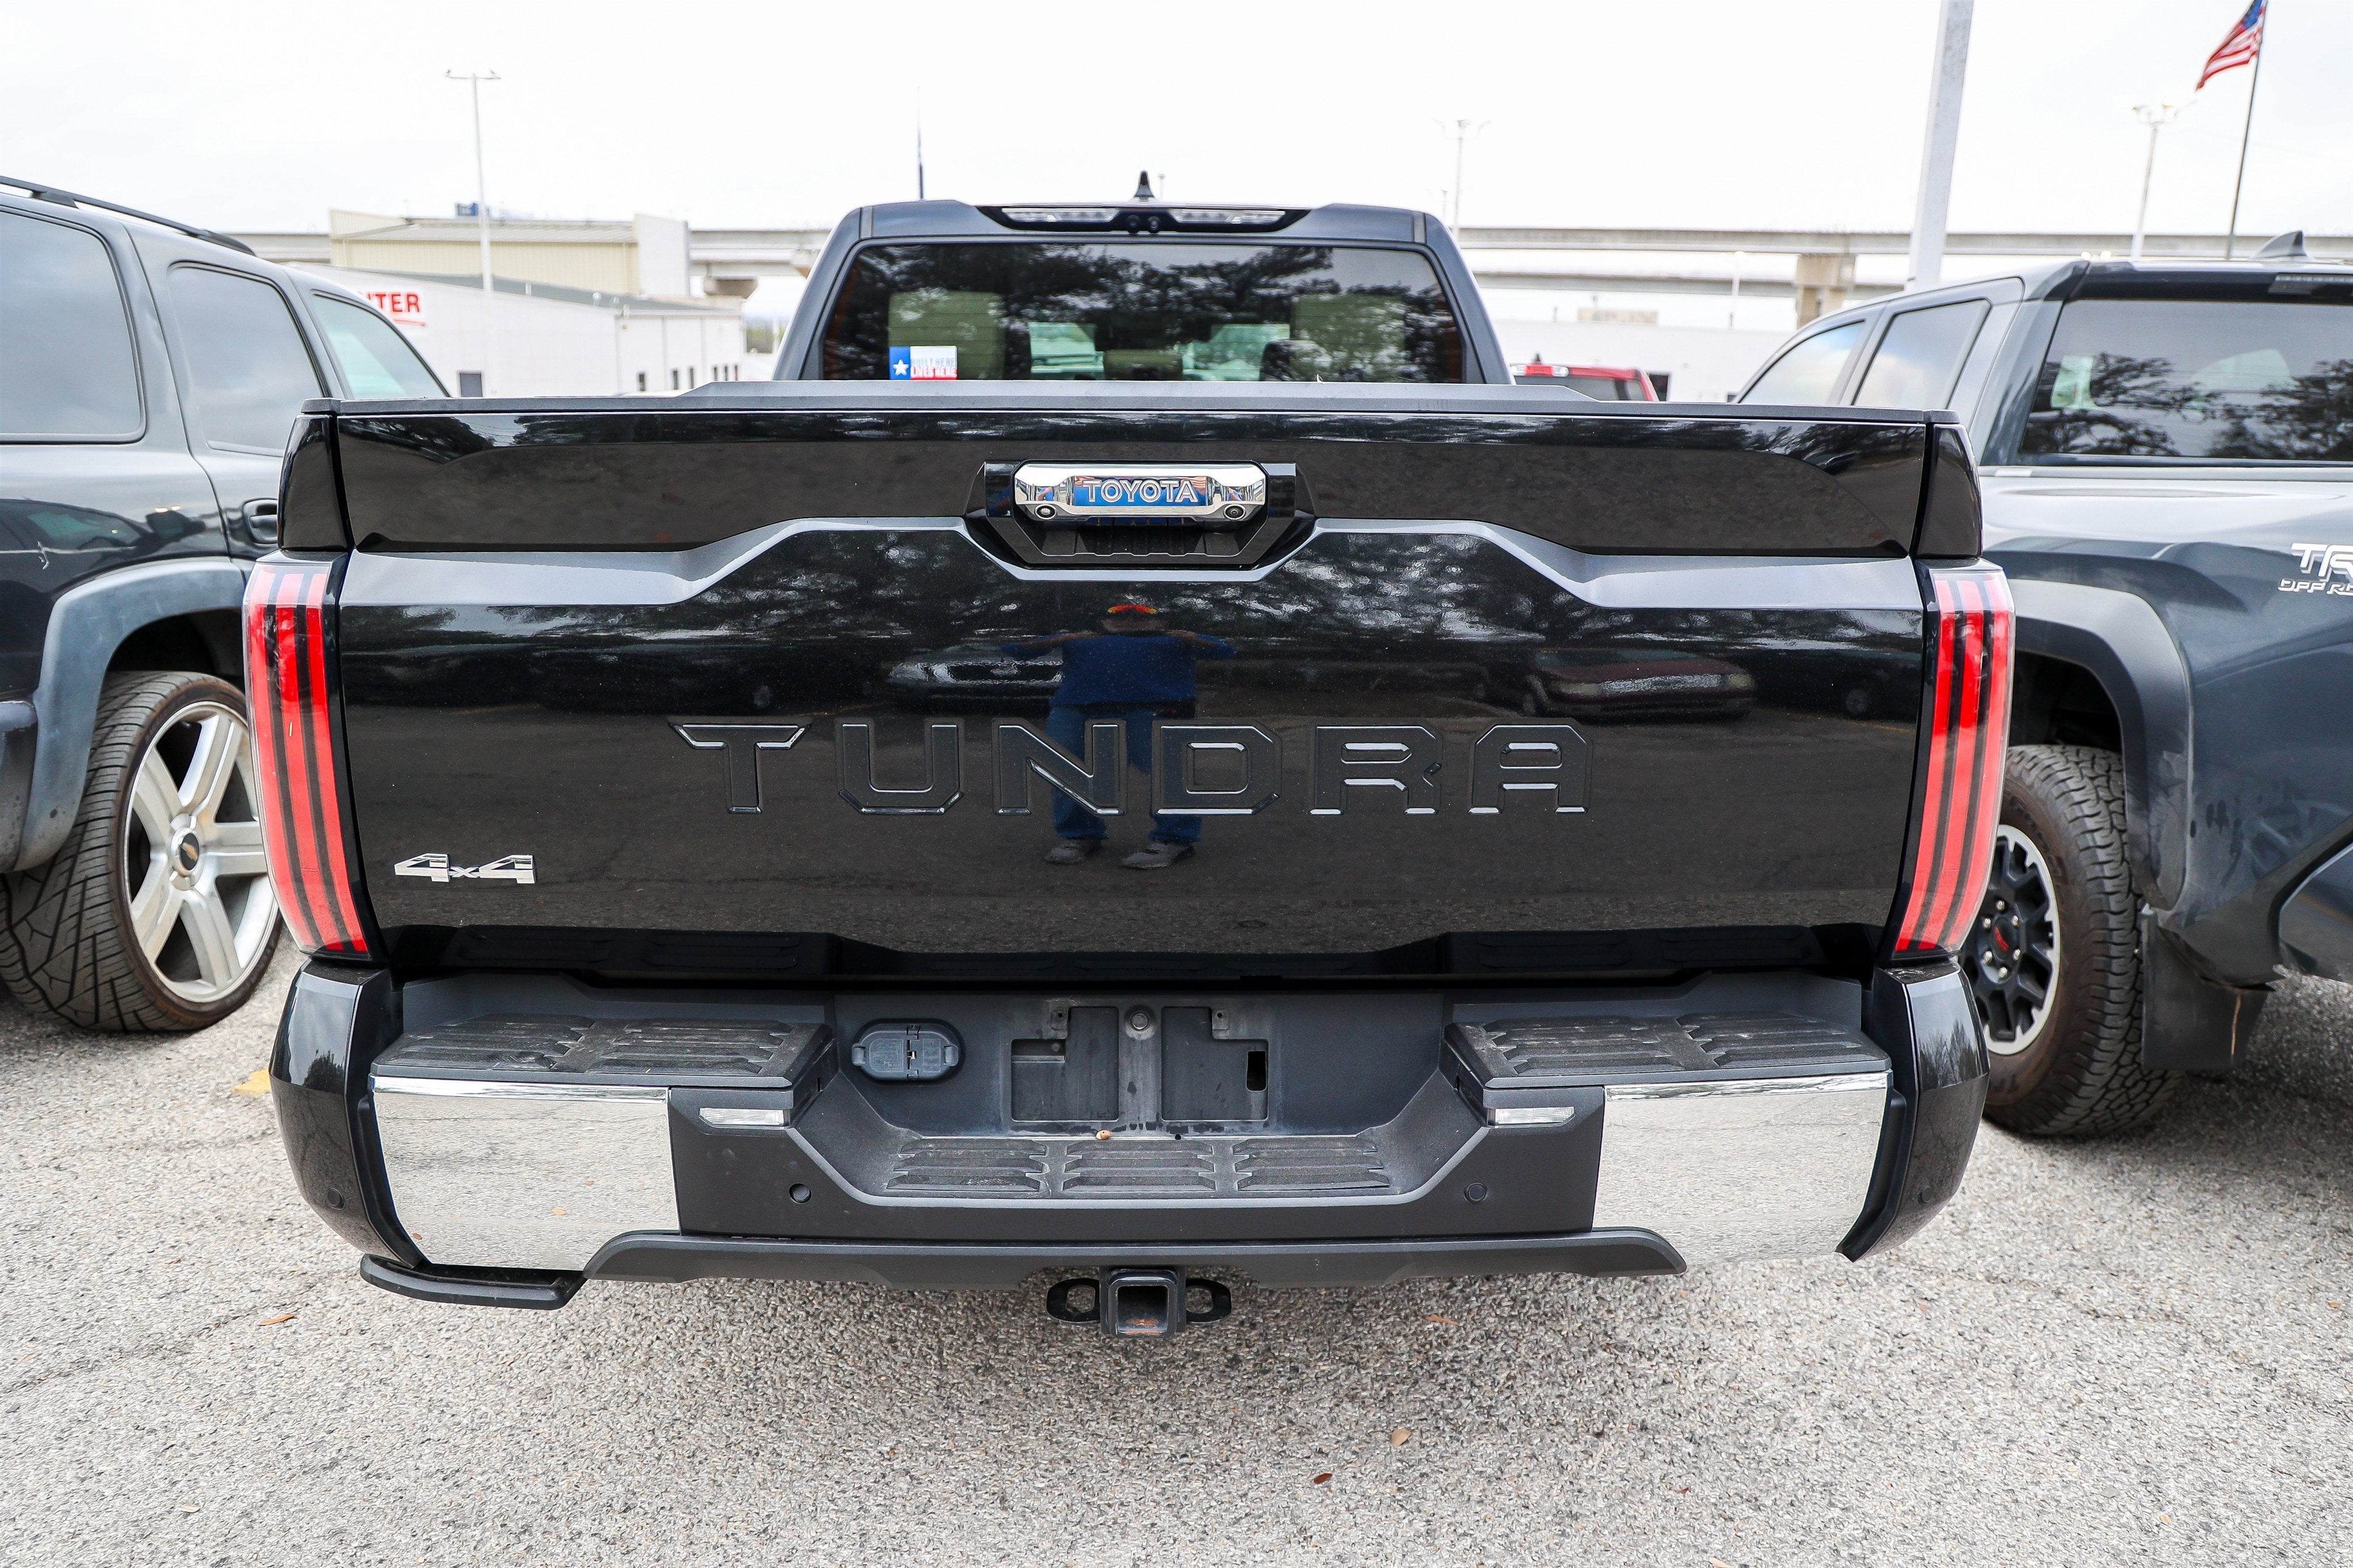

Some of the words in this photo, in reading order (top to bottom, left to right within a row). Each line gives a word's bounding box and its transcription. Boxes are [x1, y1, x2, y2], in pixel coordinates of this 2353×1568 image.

[1082, 479, 1199, 503] TOYOTA
[2278, 578, 2326, 593] OFF
[669, 720, 1590, 816] TUNDRA
[394, 853, 535, 884] 4x4
